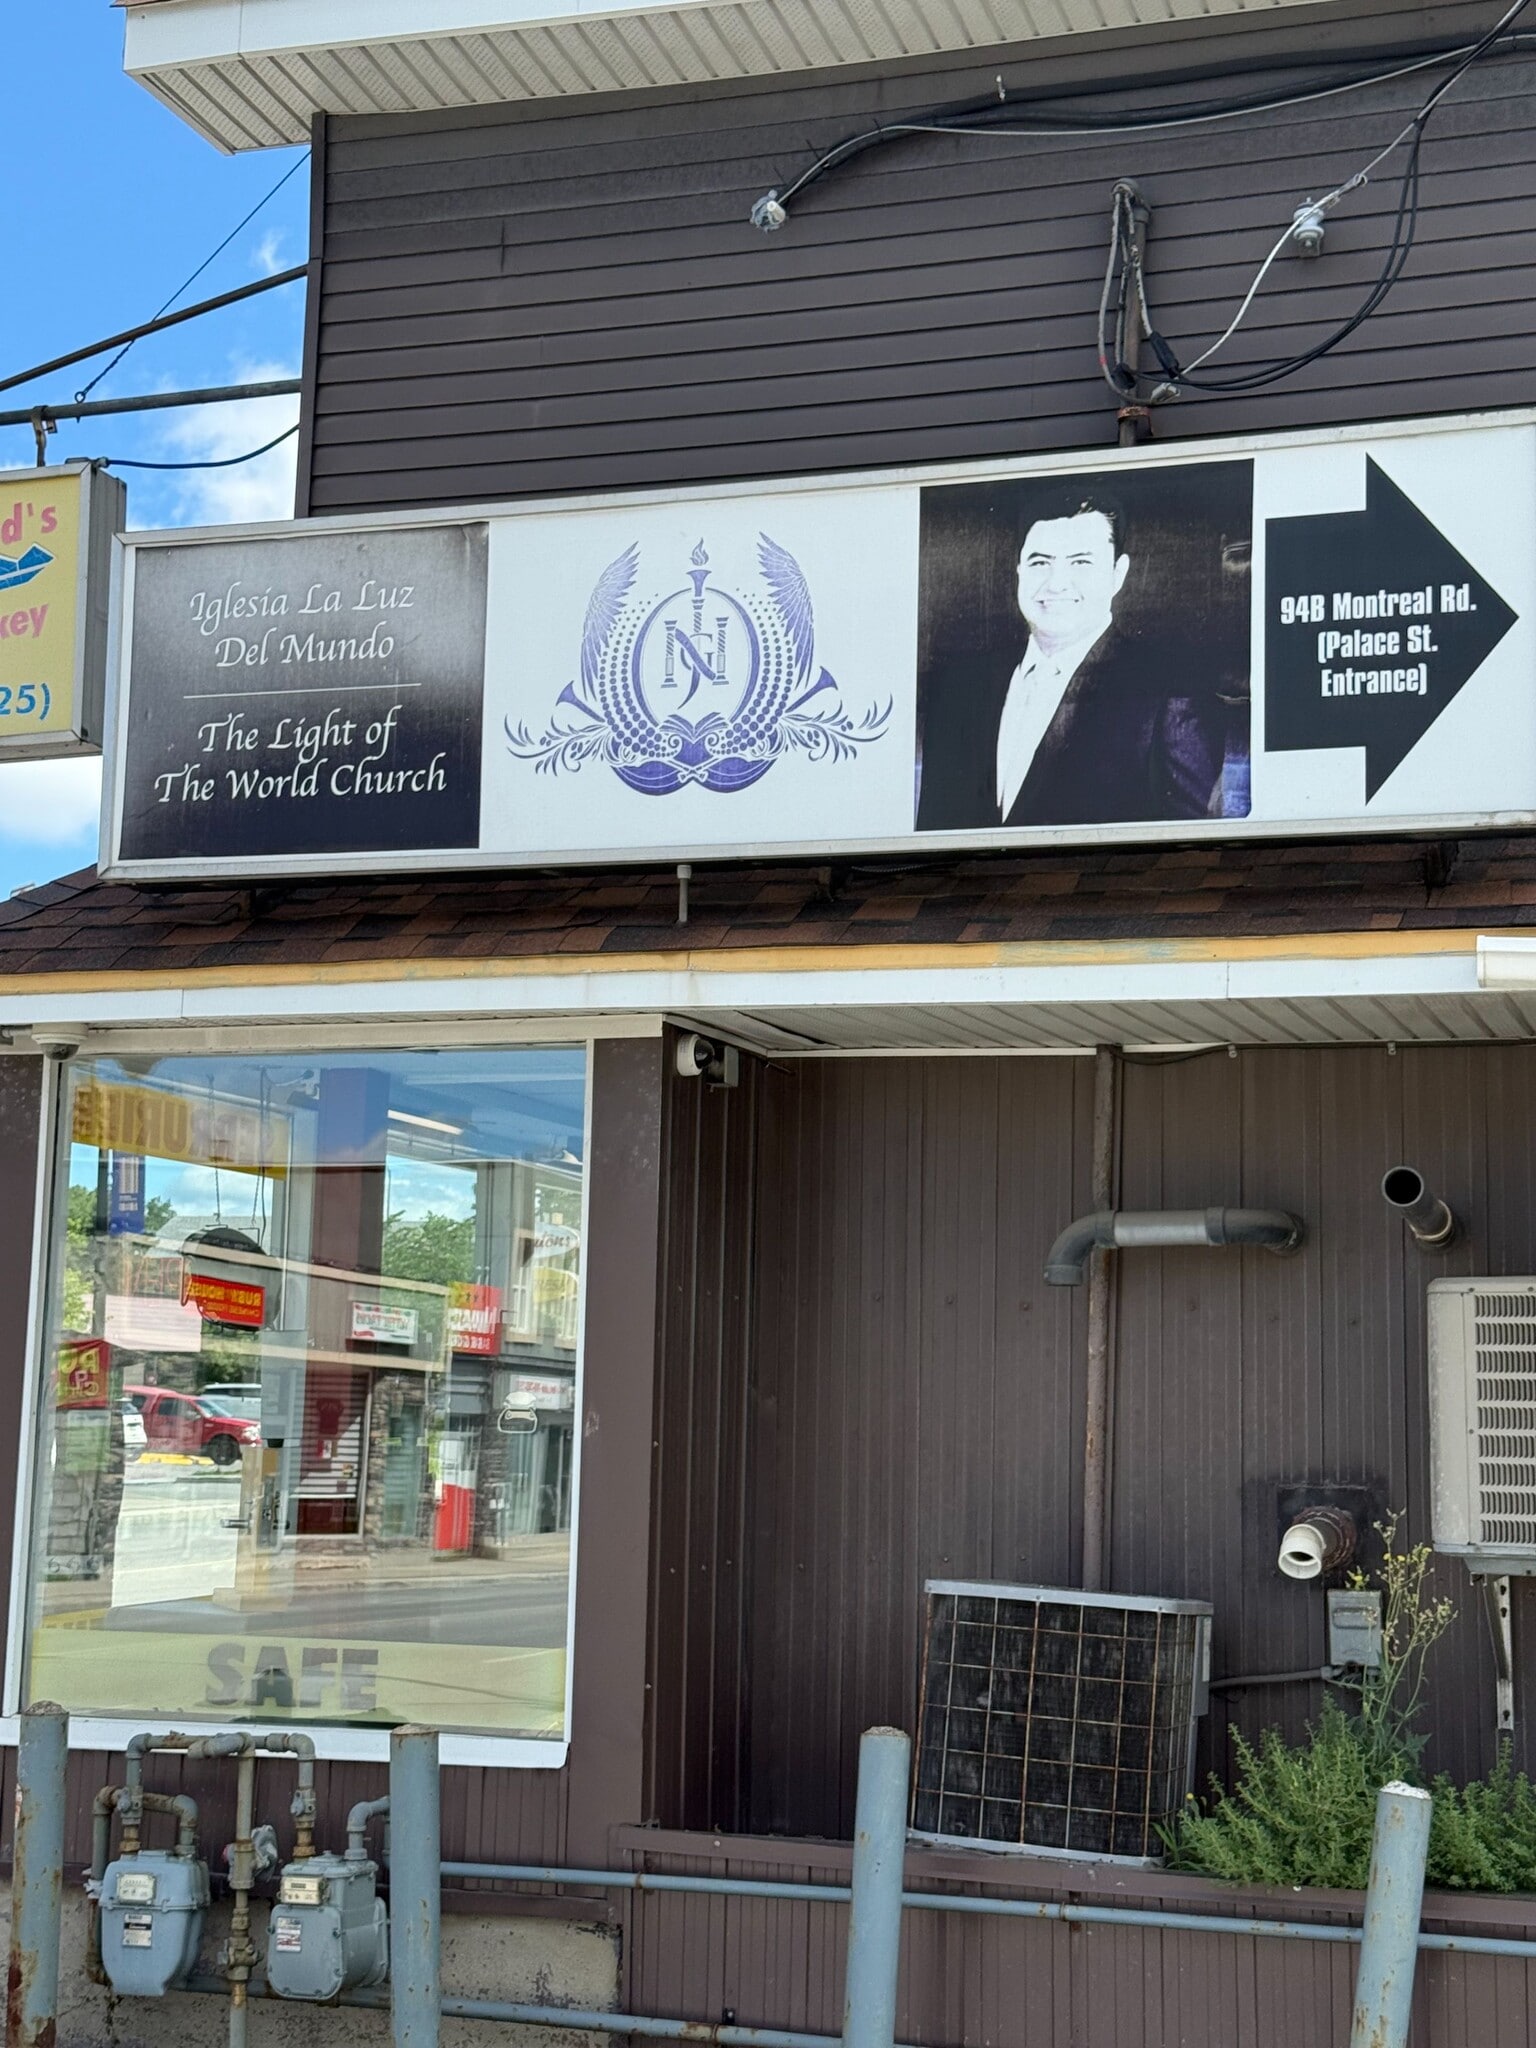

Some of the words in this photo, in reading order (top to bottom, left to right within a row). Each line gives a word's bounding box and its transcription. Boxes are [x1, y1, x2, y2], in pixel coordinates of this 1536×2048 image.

[189, 581, 289, 636] Iglesia
[298, 584, 341, 614] La
[352, 580, 415, 611] Luz
[1280, 594, 1325, 625] 94B
[1332, 585, 1433, 621] Montreal
[1440, 583, 1477, 613] Rd.
[215, 627, 277, 667] Del
[280, 621, 395, 664] Mundo
[1318, 630, 1400, 663] (Palace
[1407, 624, 1438, 654] St.
[1321, 663, 1427, 697] Entrance)
[198, 713, 258, 752] The
[268, 708, 356, 763] Light
[365, 705, 403, 763] of
[154, 764, 215, 803] The
[226, 758, 319, 801] World
[330, 752, 447, 796] Church
[205, 1642, 379, 1710] SAFE
